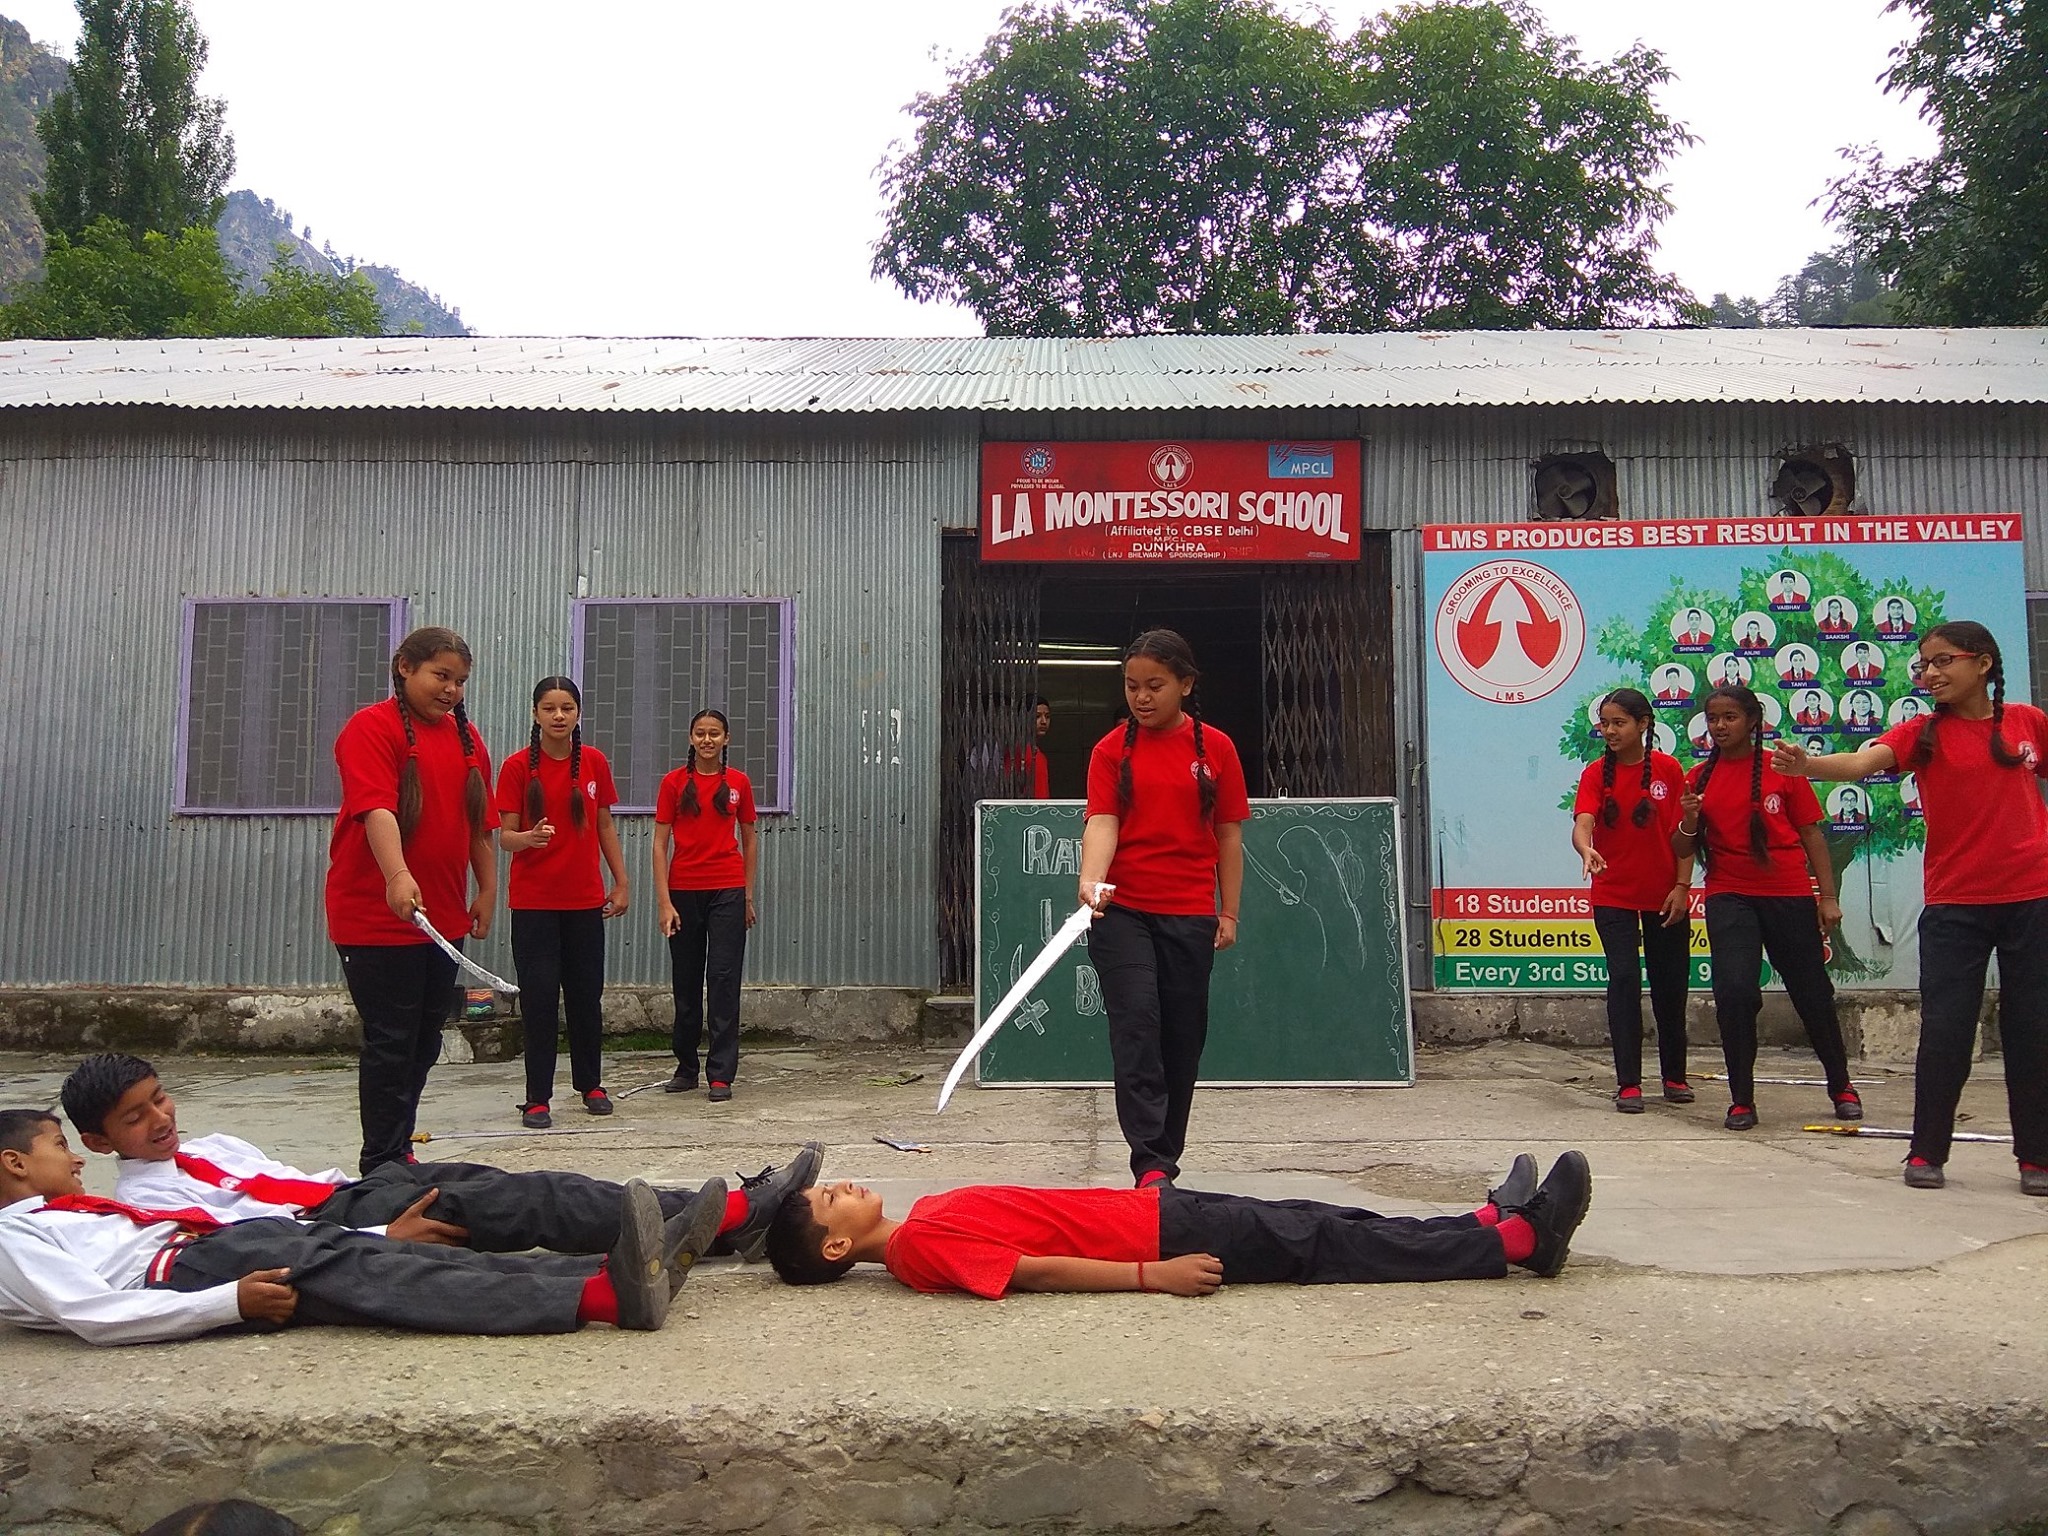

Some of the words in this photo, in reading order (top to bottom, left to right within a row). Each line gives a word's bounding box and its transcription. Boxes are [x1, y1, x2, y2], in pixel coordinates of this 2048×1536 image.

[1290, 462, 1329, 475] MPCL
[992, 492, 1034, 545] LA
[1045, 491, 1229, 532] MONTESSORI
[1238, 490, 1349, 544] SCHOOL
[1105, 525, 1161, 536] (Affiliated
[1166, 526, 1178, 535] to
[1183, 525, 1223, 536] CBSE
[1228, 525, 1259, 537] Delhi)
[1436, 530, 1488, 549] LMS
[1496, 527, 1634, 548] PRODUCES
[1642, 525, 1708, 545] BEST
[1717, 523, 1815, 543] RESULT
[1824, 522, 1850, 541] IN
[1858, 521, 1909, 541] THE
[1915, 520, 2014, 540] VALLEY
[1133, 543, 1206, 552] DUNKHRA
[1445, 570, 1491, 615] GROOMING
[1493, 566, 1509, 576] TO
[1511, 566, 1573, 612] EXCELLENCE
[1496, 691, 1525, 700] LMS
[1454, 894, 1480, 913] 18
[1487, 894, 1590, 914] Students
[1455, 929, 1481, 947] 28
[1489, 929, 1592, 947] Students
[1455, 962, 1521, 986] Every
[1528, 962, 1566, 982] 3rd
